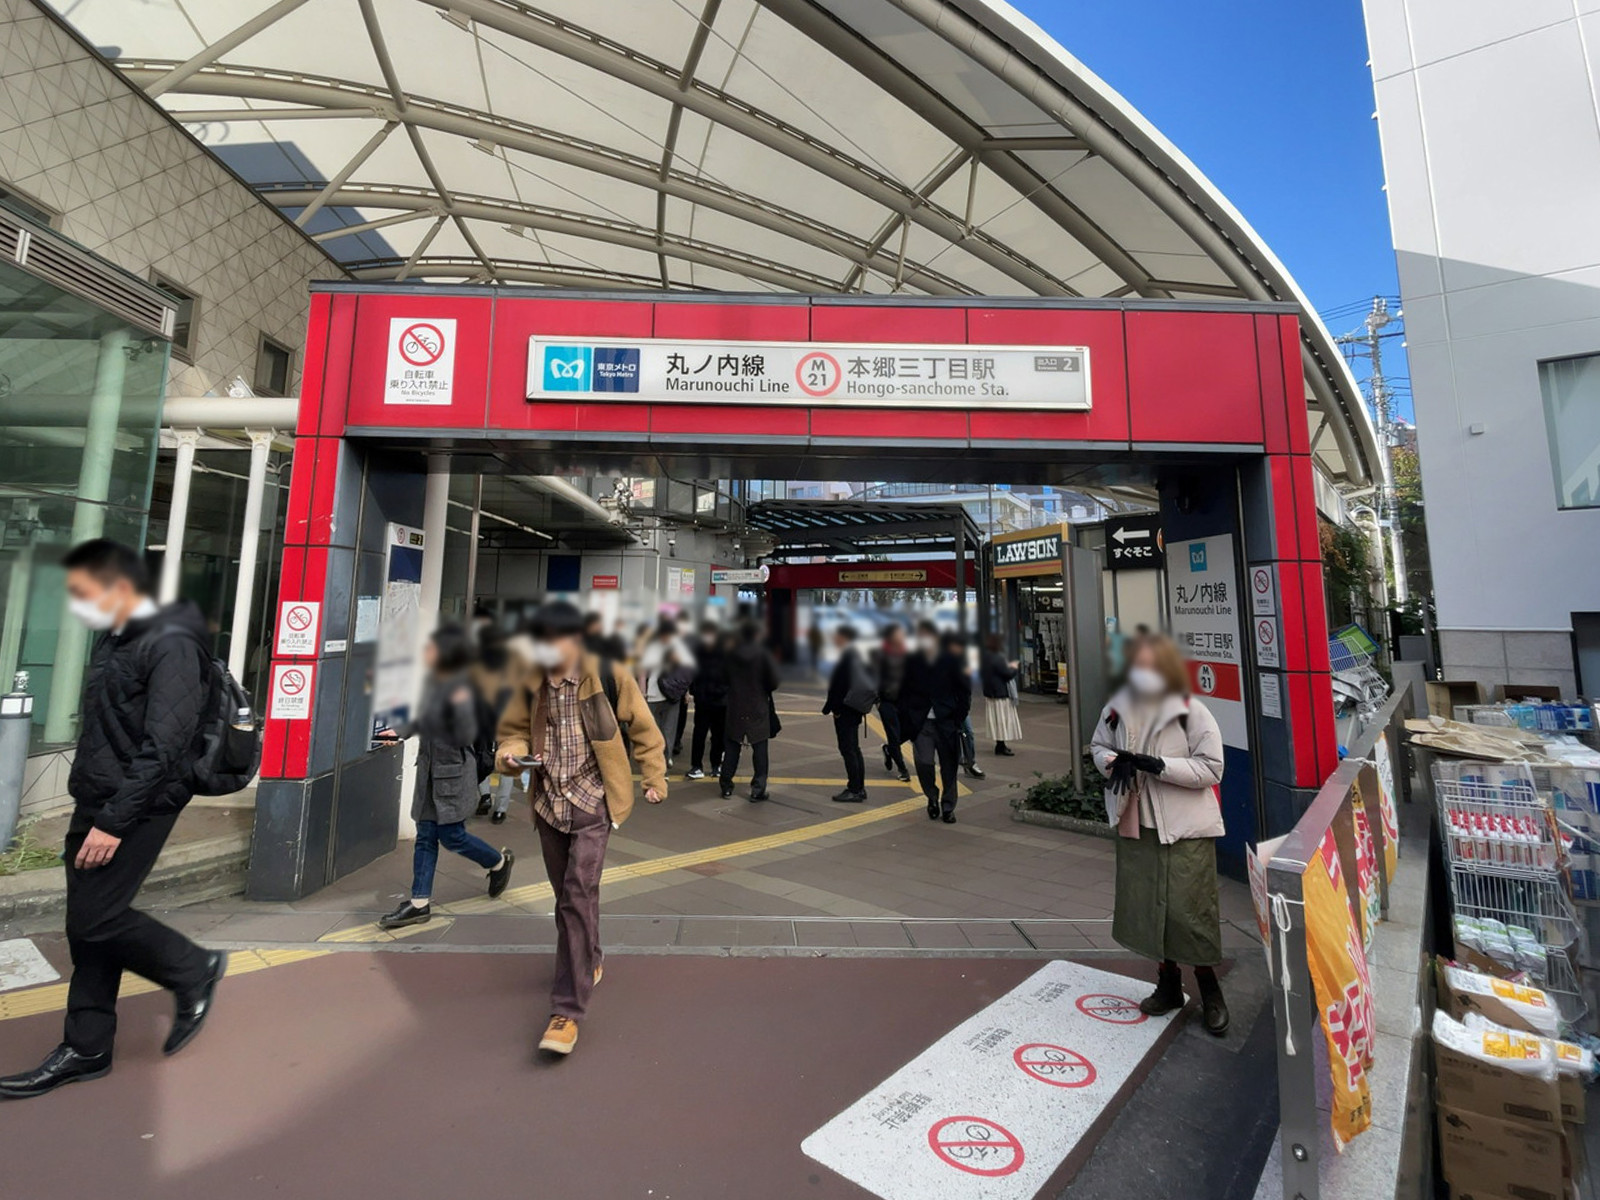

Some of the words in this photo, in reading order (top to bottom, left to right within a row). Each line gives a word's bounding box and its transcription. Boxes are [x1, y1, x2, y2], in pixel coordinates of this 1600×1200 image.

[597, 363, 636, 372] 東京メトロ
[666, 353, 765, 377] 丸ノ内線
[811, 360, 826, 371] M
[848, 356, 996, 380] 本郷三丁目駅
[1063, 358, 1072, 370] 2
[404, 370, 434, 379] 自転車
[808, 373, 827, 386] 21
[390, 379, 448, 390] 乗り入れ禁止
[666, 378, 754, 392] Marunouchi
[760, 379, 790, 393] Line
[847, 380, 976, 397] Hongo-sanchome
[980, 382, 1009, 396] Sta.
[996, 536, 1058, 564] LAWSON
[1112, 546, 1152, 558] すぐそこ
[1176, 582, 1228, 604] 丸ノ内線
[1175, 604, 1215, 615] Marunouchi
[1216, 606, 1232, 615] Line
[1179, 632, 1234, 649] 郷三丁目駅
[1202, 666, 1210, 675] M
[1201, 676, 1211, 689] 21
